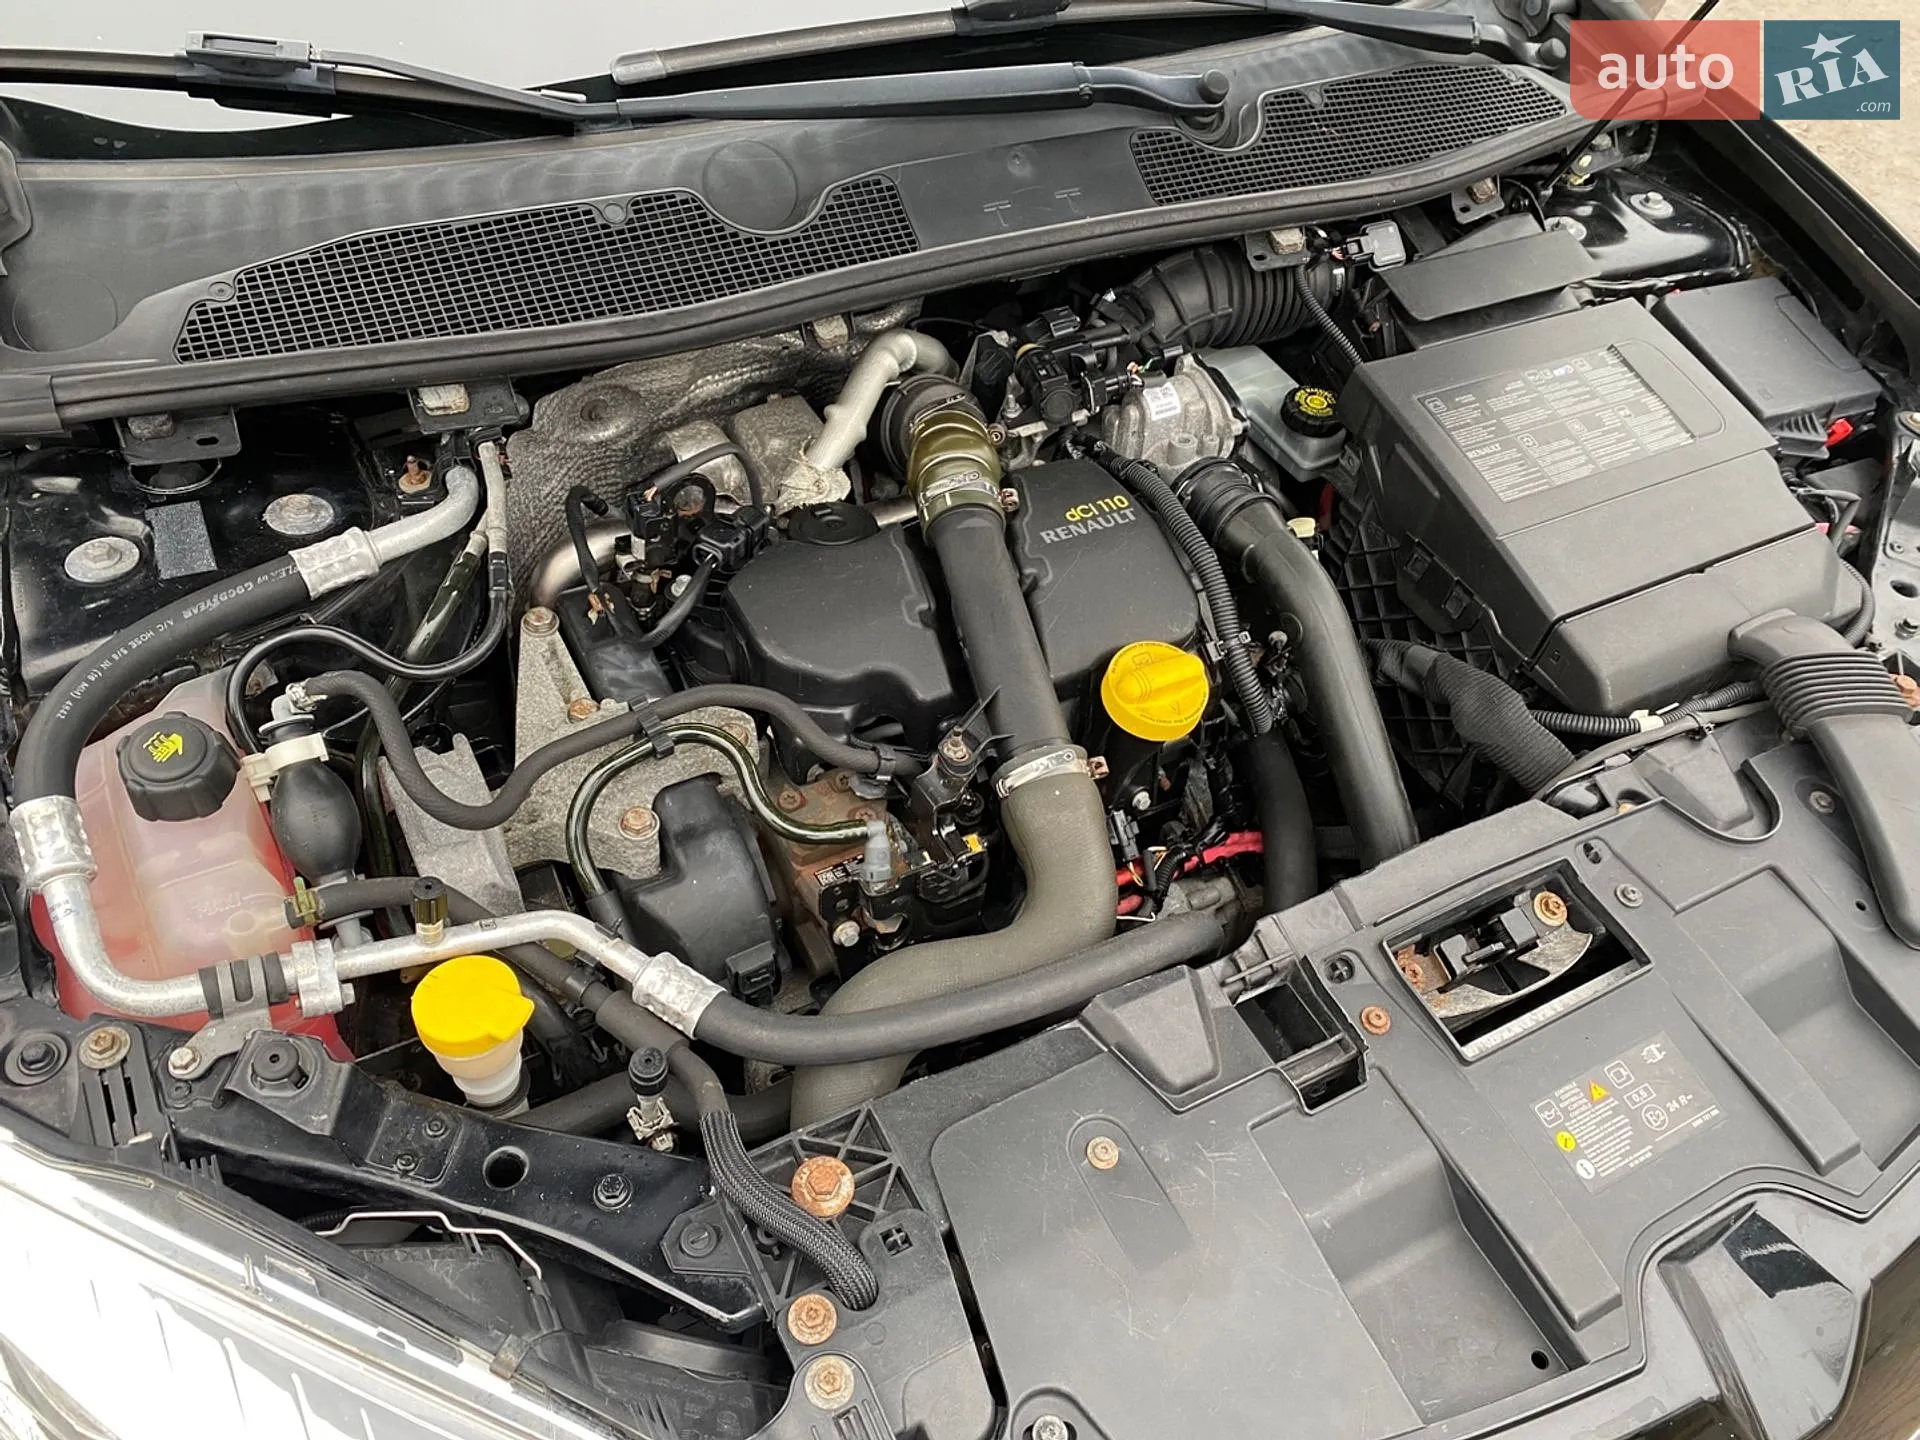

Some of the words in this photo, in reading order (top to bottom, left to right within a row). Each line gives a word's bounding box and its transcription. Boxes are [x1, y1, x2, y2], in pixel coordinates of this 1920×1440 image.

[1096, 495, 1129, 512] 110
[1040, 508, 1136, 543] RENAULT
[182, 581, 254, 619] GOODYEAR
[157, 618, 174, 632] A/C
[128, 631, 154, 649] HOSE
